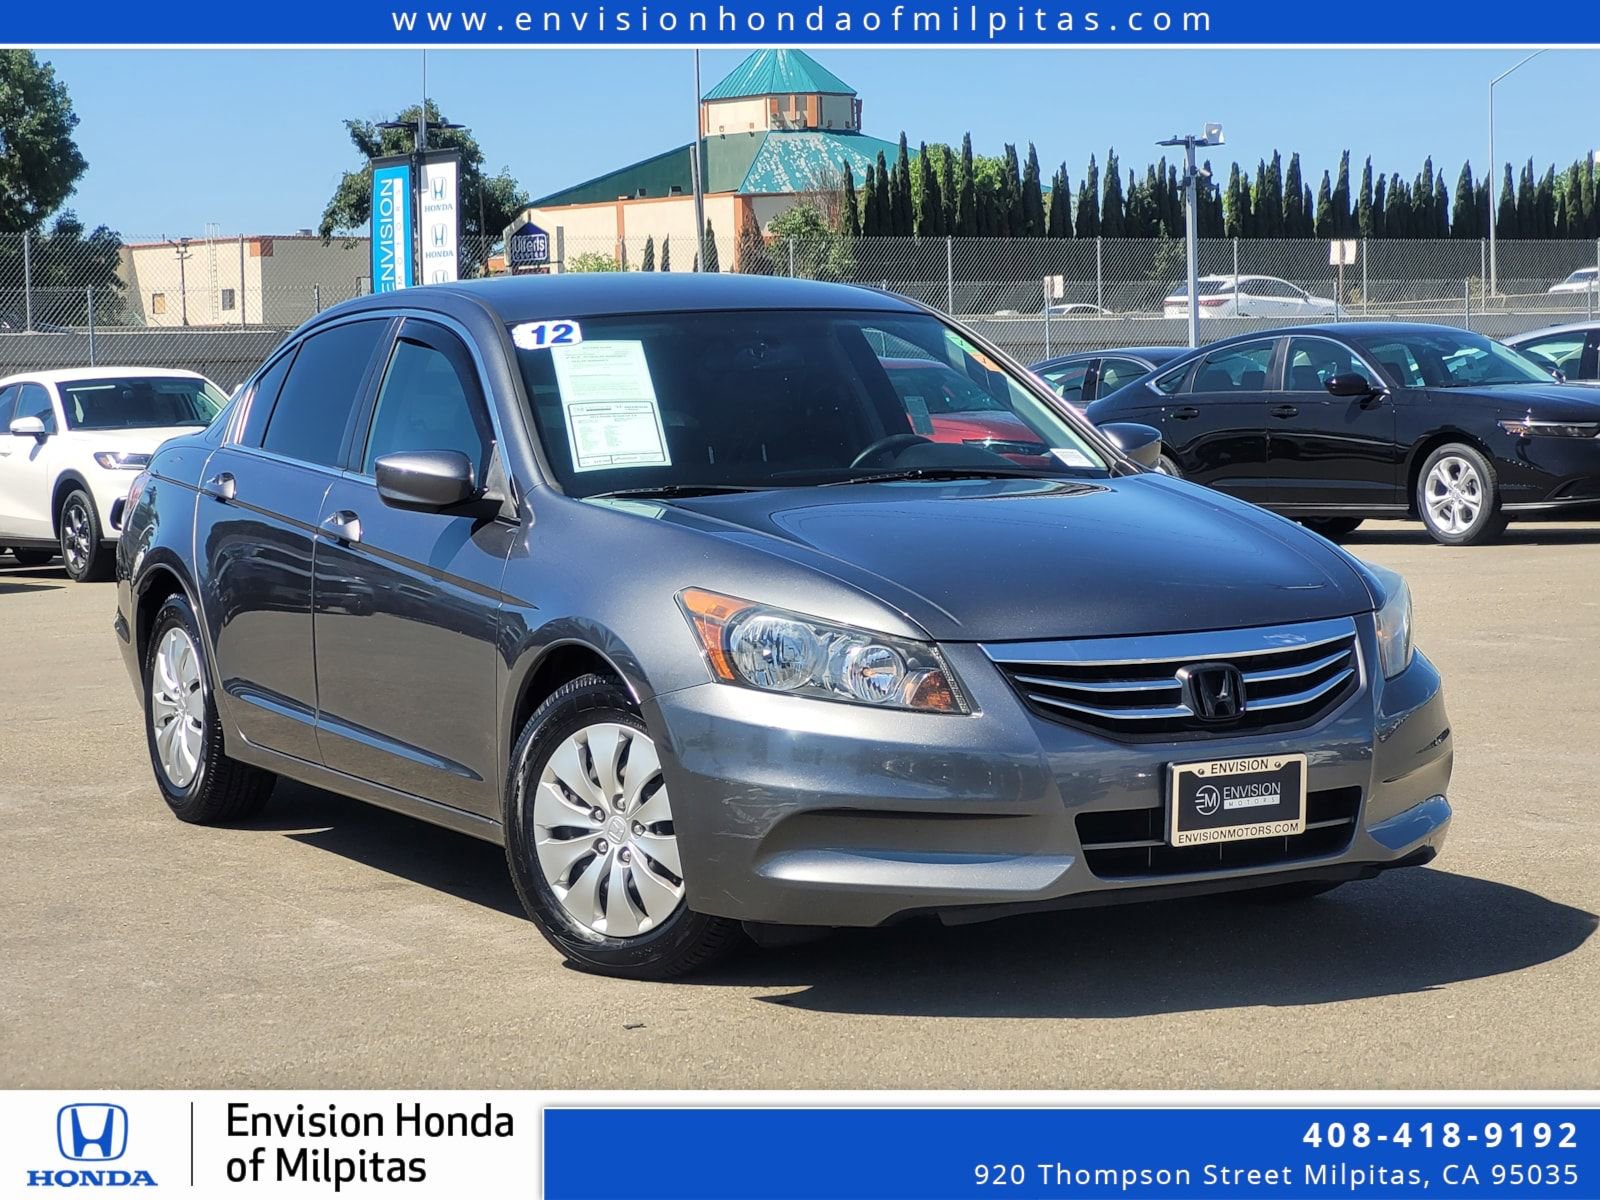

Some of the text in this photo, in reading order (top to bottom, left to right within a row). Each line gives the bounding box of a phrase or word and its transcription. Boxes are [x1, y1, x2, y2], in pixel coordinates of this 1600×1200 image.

[424, 203, 454, 213] HONDA
[380, 178, 395, 293] ENVISION
[424, 249, 455, 259] HONDA
[531, 323, 574, 345] 12
[1210, 758, 1269, 775] ENVISION
[1223, 781, 1281, 800] ENVISION
[1228, 796, 1276, 808] MOTORS
[1178, 822, 1299, 844] ENVISIONMOTORS.COM
